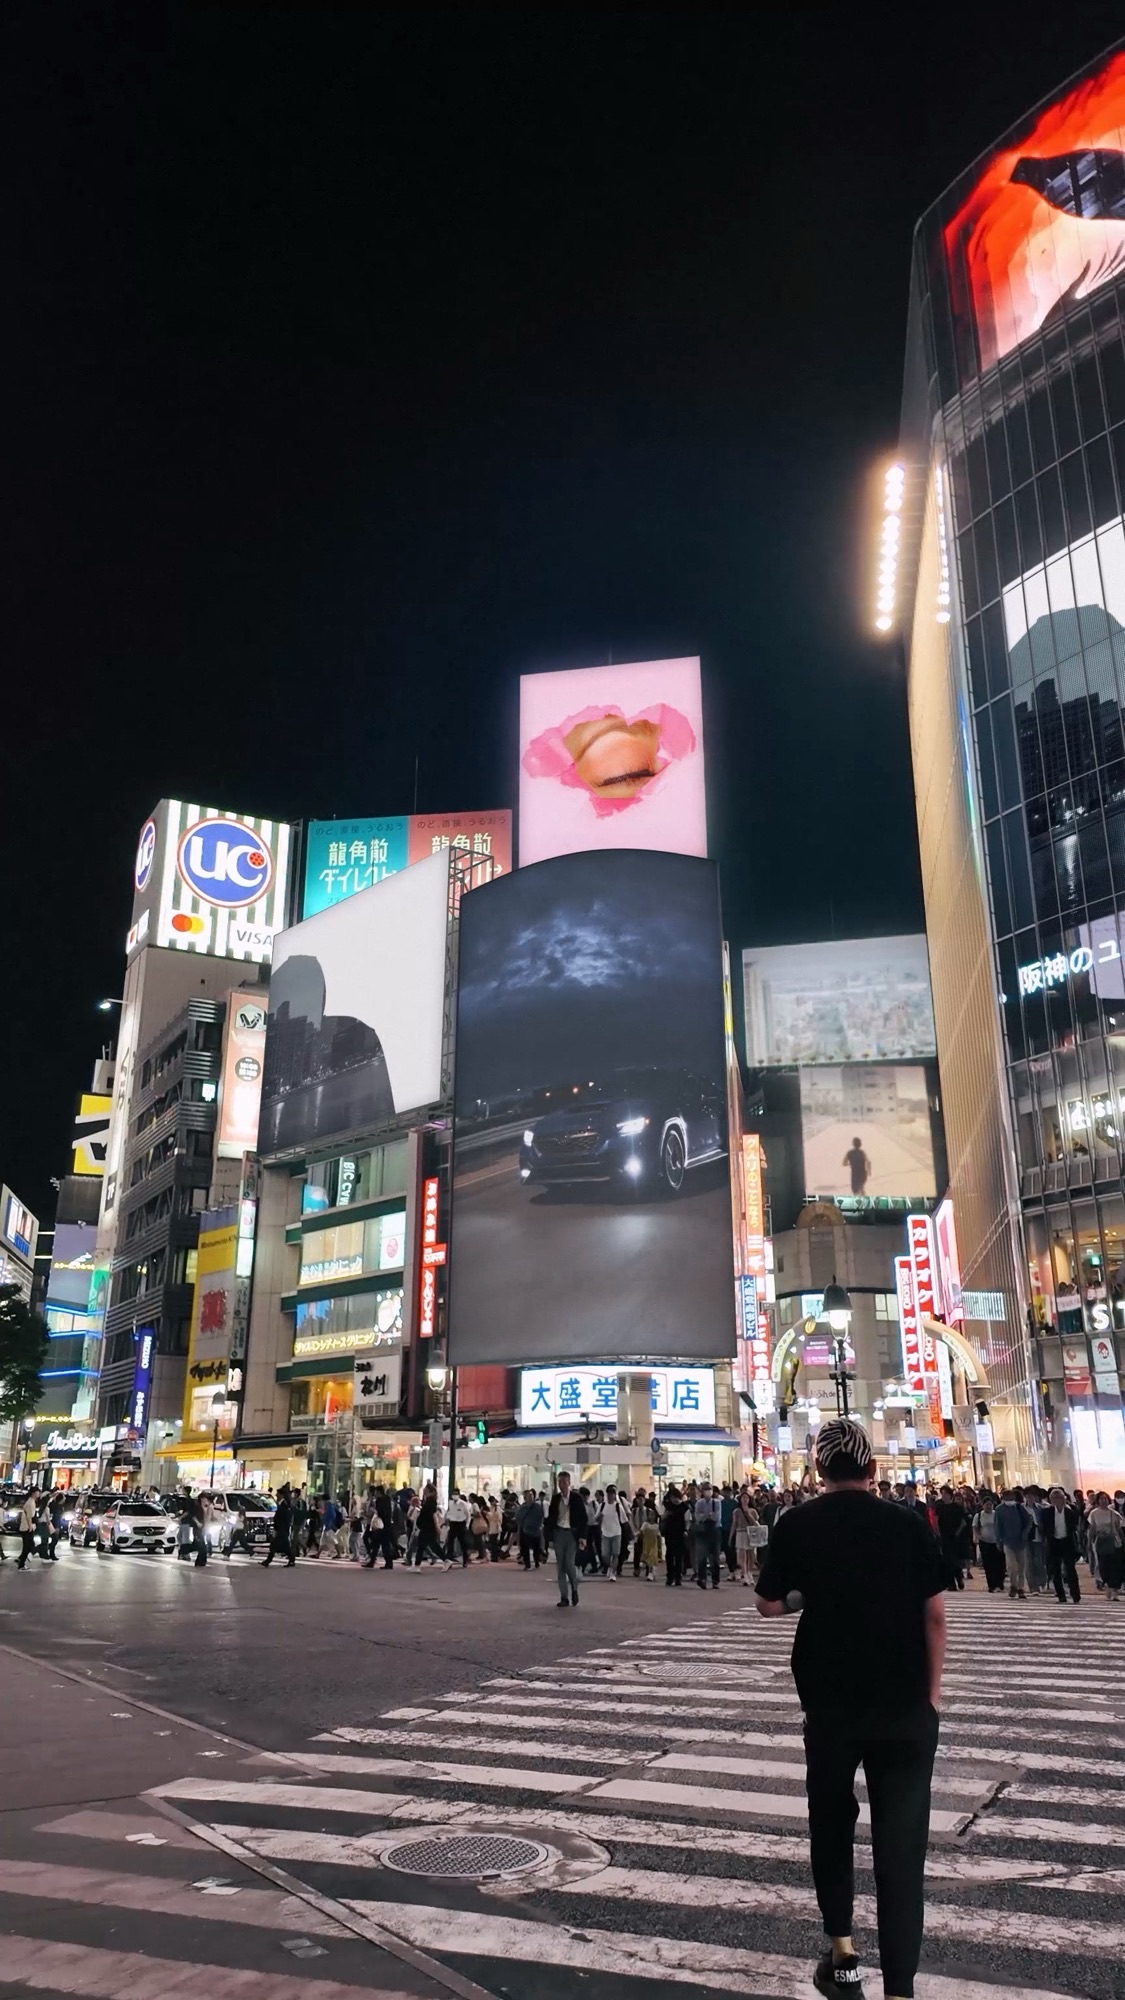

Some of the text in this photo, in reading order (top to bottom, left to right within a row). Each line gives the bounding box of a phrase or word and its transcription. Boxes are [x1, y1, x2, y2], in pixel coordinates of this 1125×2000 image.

[190, 835, 263, 887] UC
[328, 838, 389, 867] 龍角散
[236, 929, 272, 947] VISA
[912, 1226, 934, 1303] カラオケ
[903, 1316, 924, 1383] カラオケ
